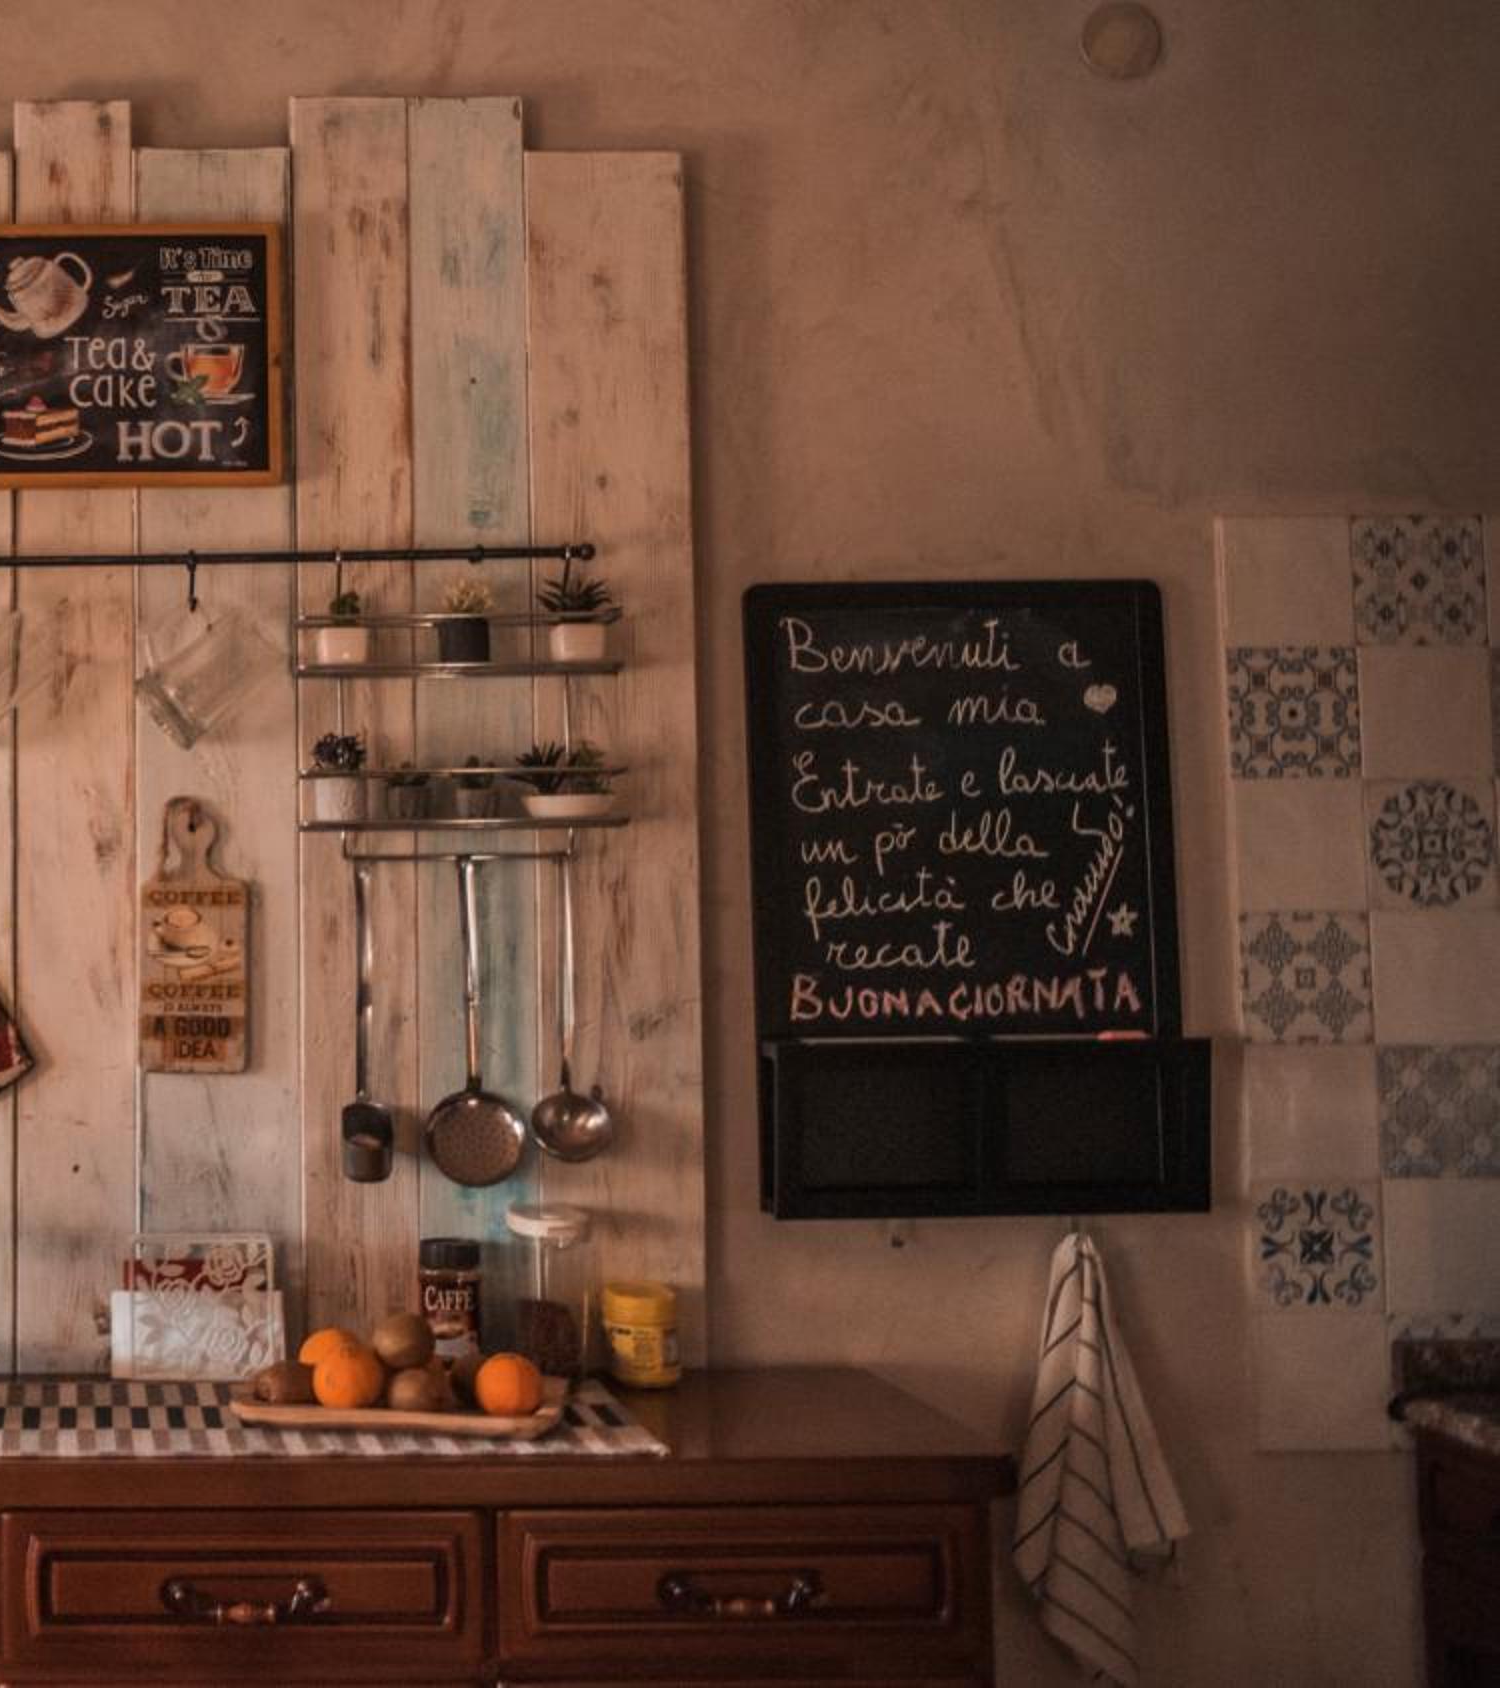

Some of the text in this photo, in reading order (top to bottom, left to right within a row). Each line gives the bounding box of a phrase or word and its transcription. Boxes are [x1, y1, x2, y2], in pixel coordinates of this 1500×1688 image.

[161, 286, 256, 313] TEA
[116, 421, 223, 461] HOT
[780, 617, 1092, 674] Benvenuti a
[795, 701, 921, 728] casa
[792, 751, 945, 812] Entrate
[961, 770, 981, 797] e
[801, 840, 858, 864] un
[940, 807, 1049, 858] della
[149, 890, 242, 905] COFFEE
[805, 866, 1060, 942] felicità che
[826, 921, 975, 970] recate
[148, 983, 242, 999] COFFEE
[154, 1016, 231, 1037] A GOOD
[173, 1041, 216, 1058] IDEA
